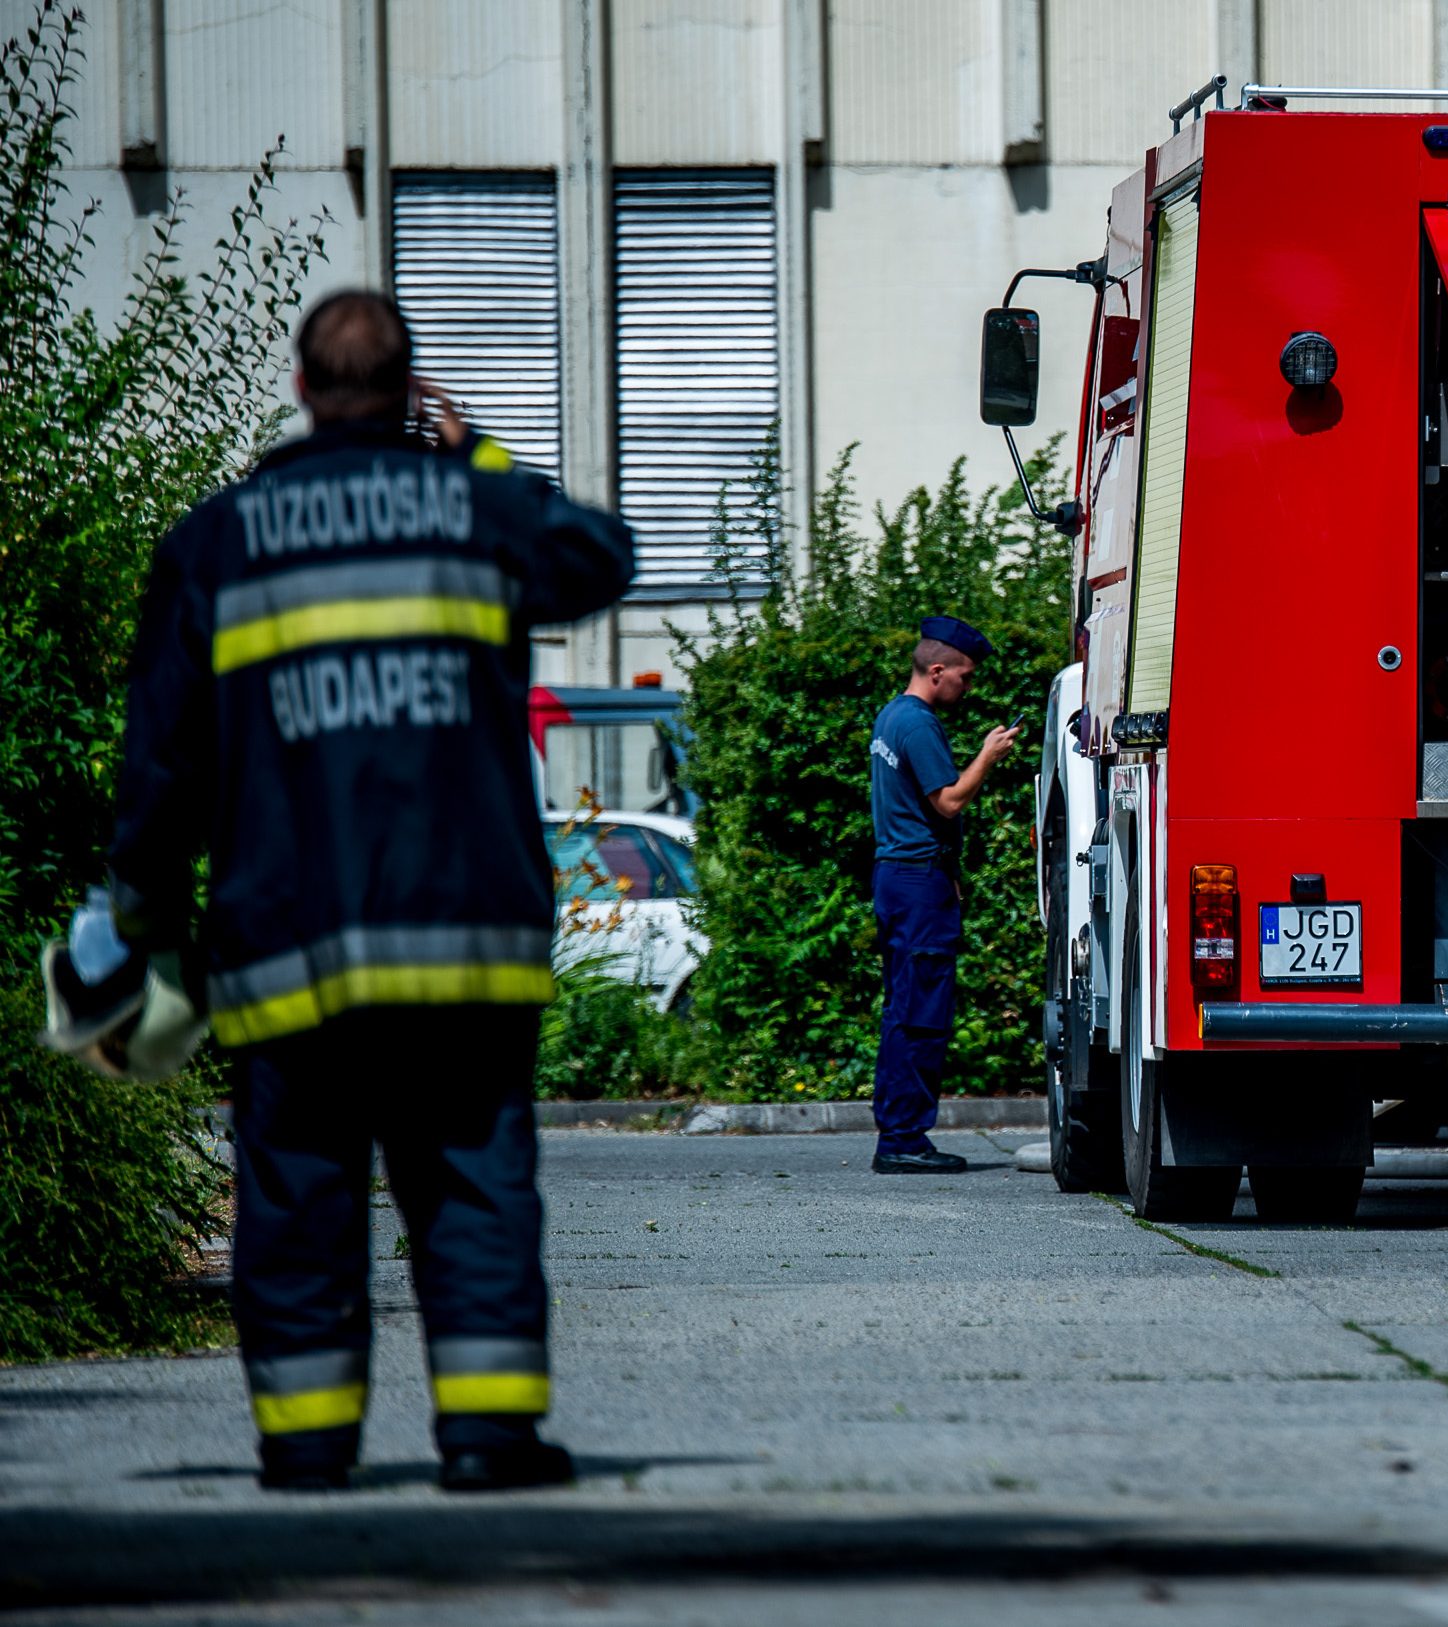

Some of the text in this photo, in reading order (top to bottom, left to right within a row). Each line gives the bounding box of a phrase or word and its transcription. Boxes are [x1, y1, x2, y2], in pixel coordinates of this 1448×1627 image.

[268, 650, 471, 742] BUDAPEST
[1266, 929, 1275, 940] H
[1283, 910, 1354, 939] JGD
[1289, 943, 1349, 972] 247
